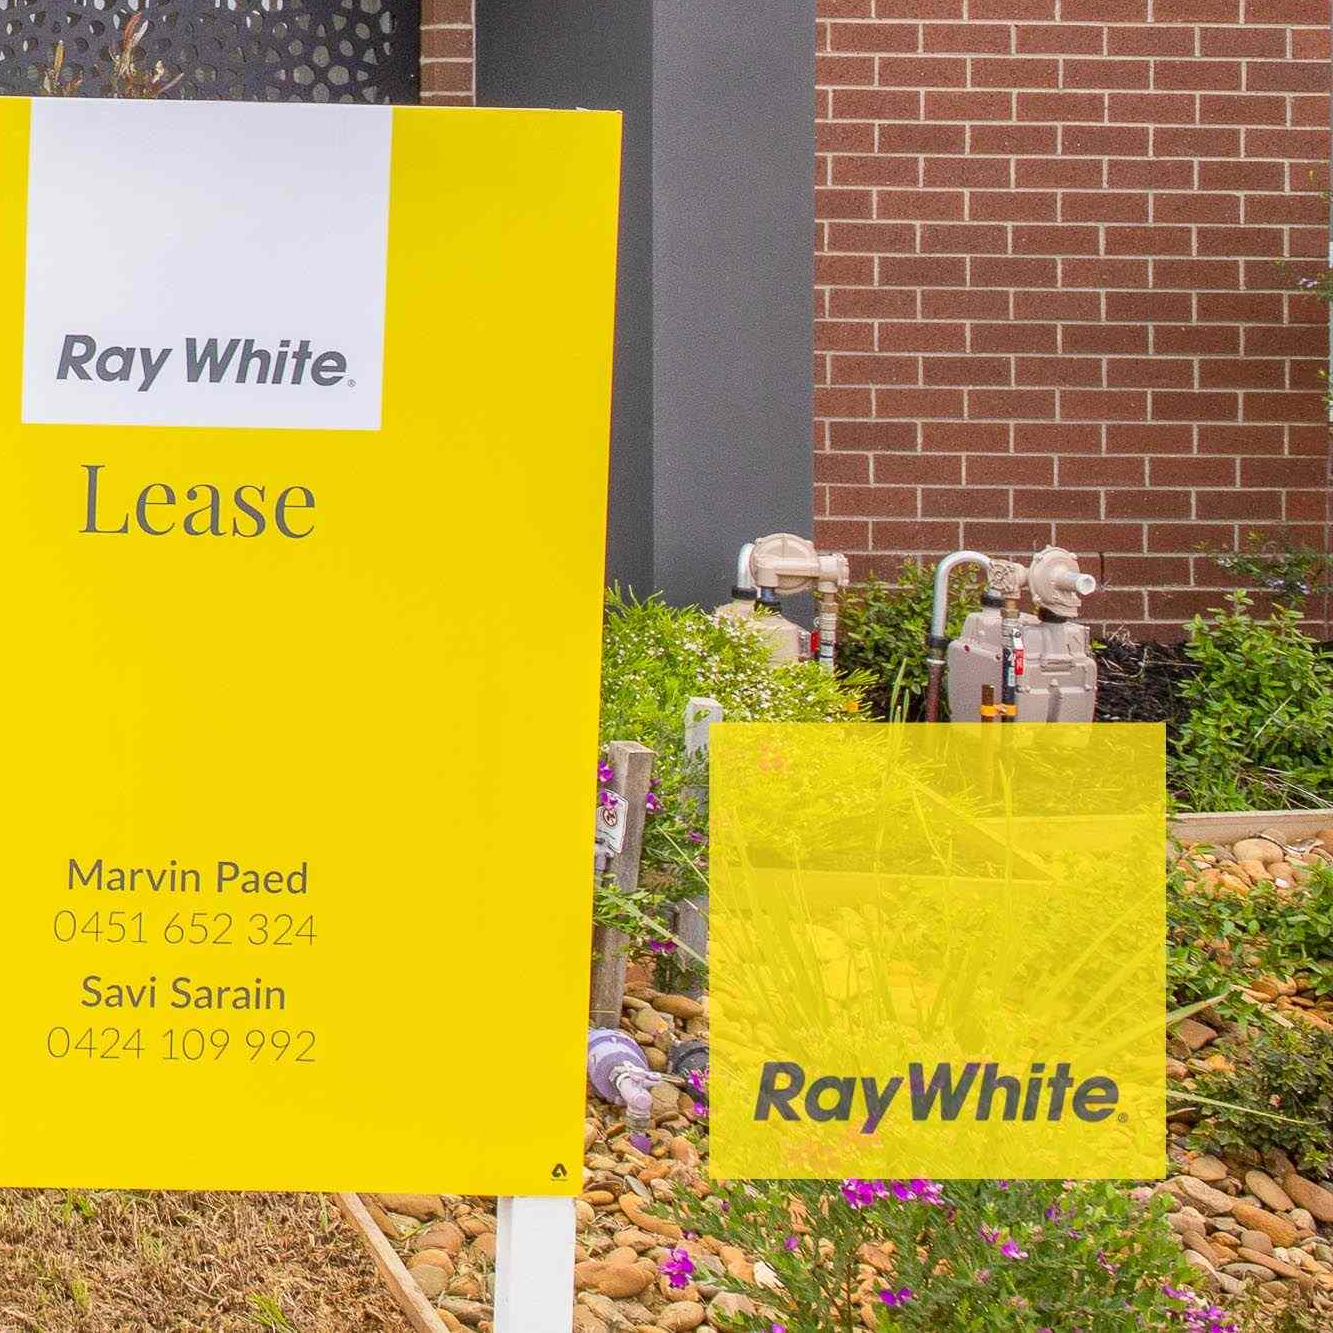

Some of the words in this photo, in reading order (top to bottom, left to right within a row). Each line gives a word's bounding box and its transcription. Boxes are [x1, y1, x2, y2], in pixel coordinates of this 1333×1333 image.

[56, 334, 174, 392] Ray
[186, 337, 347, 387] White
[78, 464, 316, 539] Lease
[68, 858, 201, 892] Marvin
[217, 861, 308, 895] Paed
[53, 909, 148, 944] 0451
[163, 912, 233, 945] 652
[247, 913, 318, 946] 324
[81, 975, 157, 1008] Savi
[170, 976, 285, 1010] Sarain
[47, 1026, 146, 1059] 0424
[162, 1028, 230, 1061] 109
[245, 1029, 316, 1062] 992
